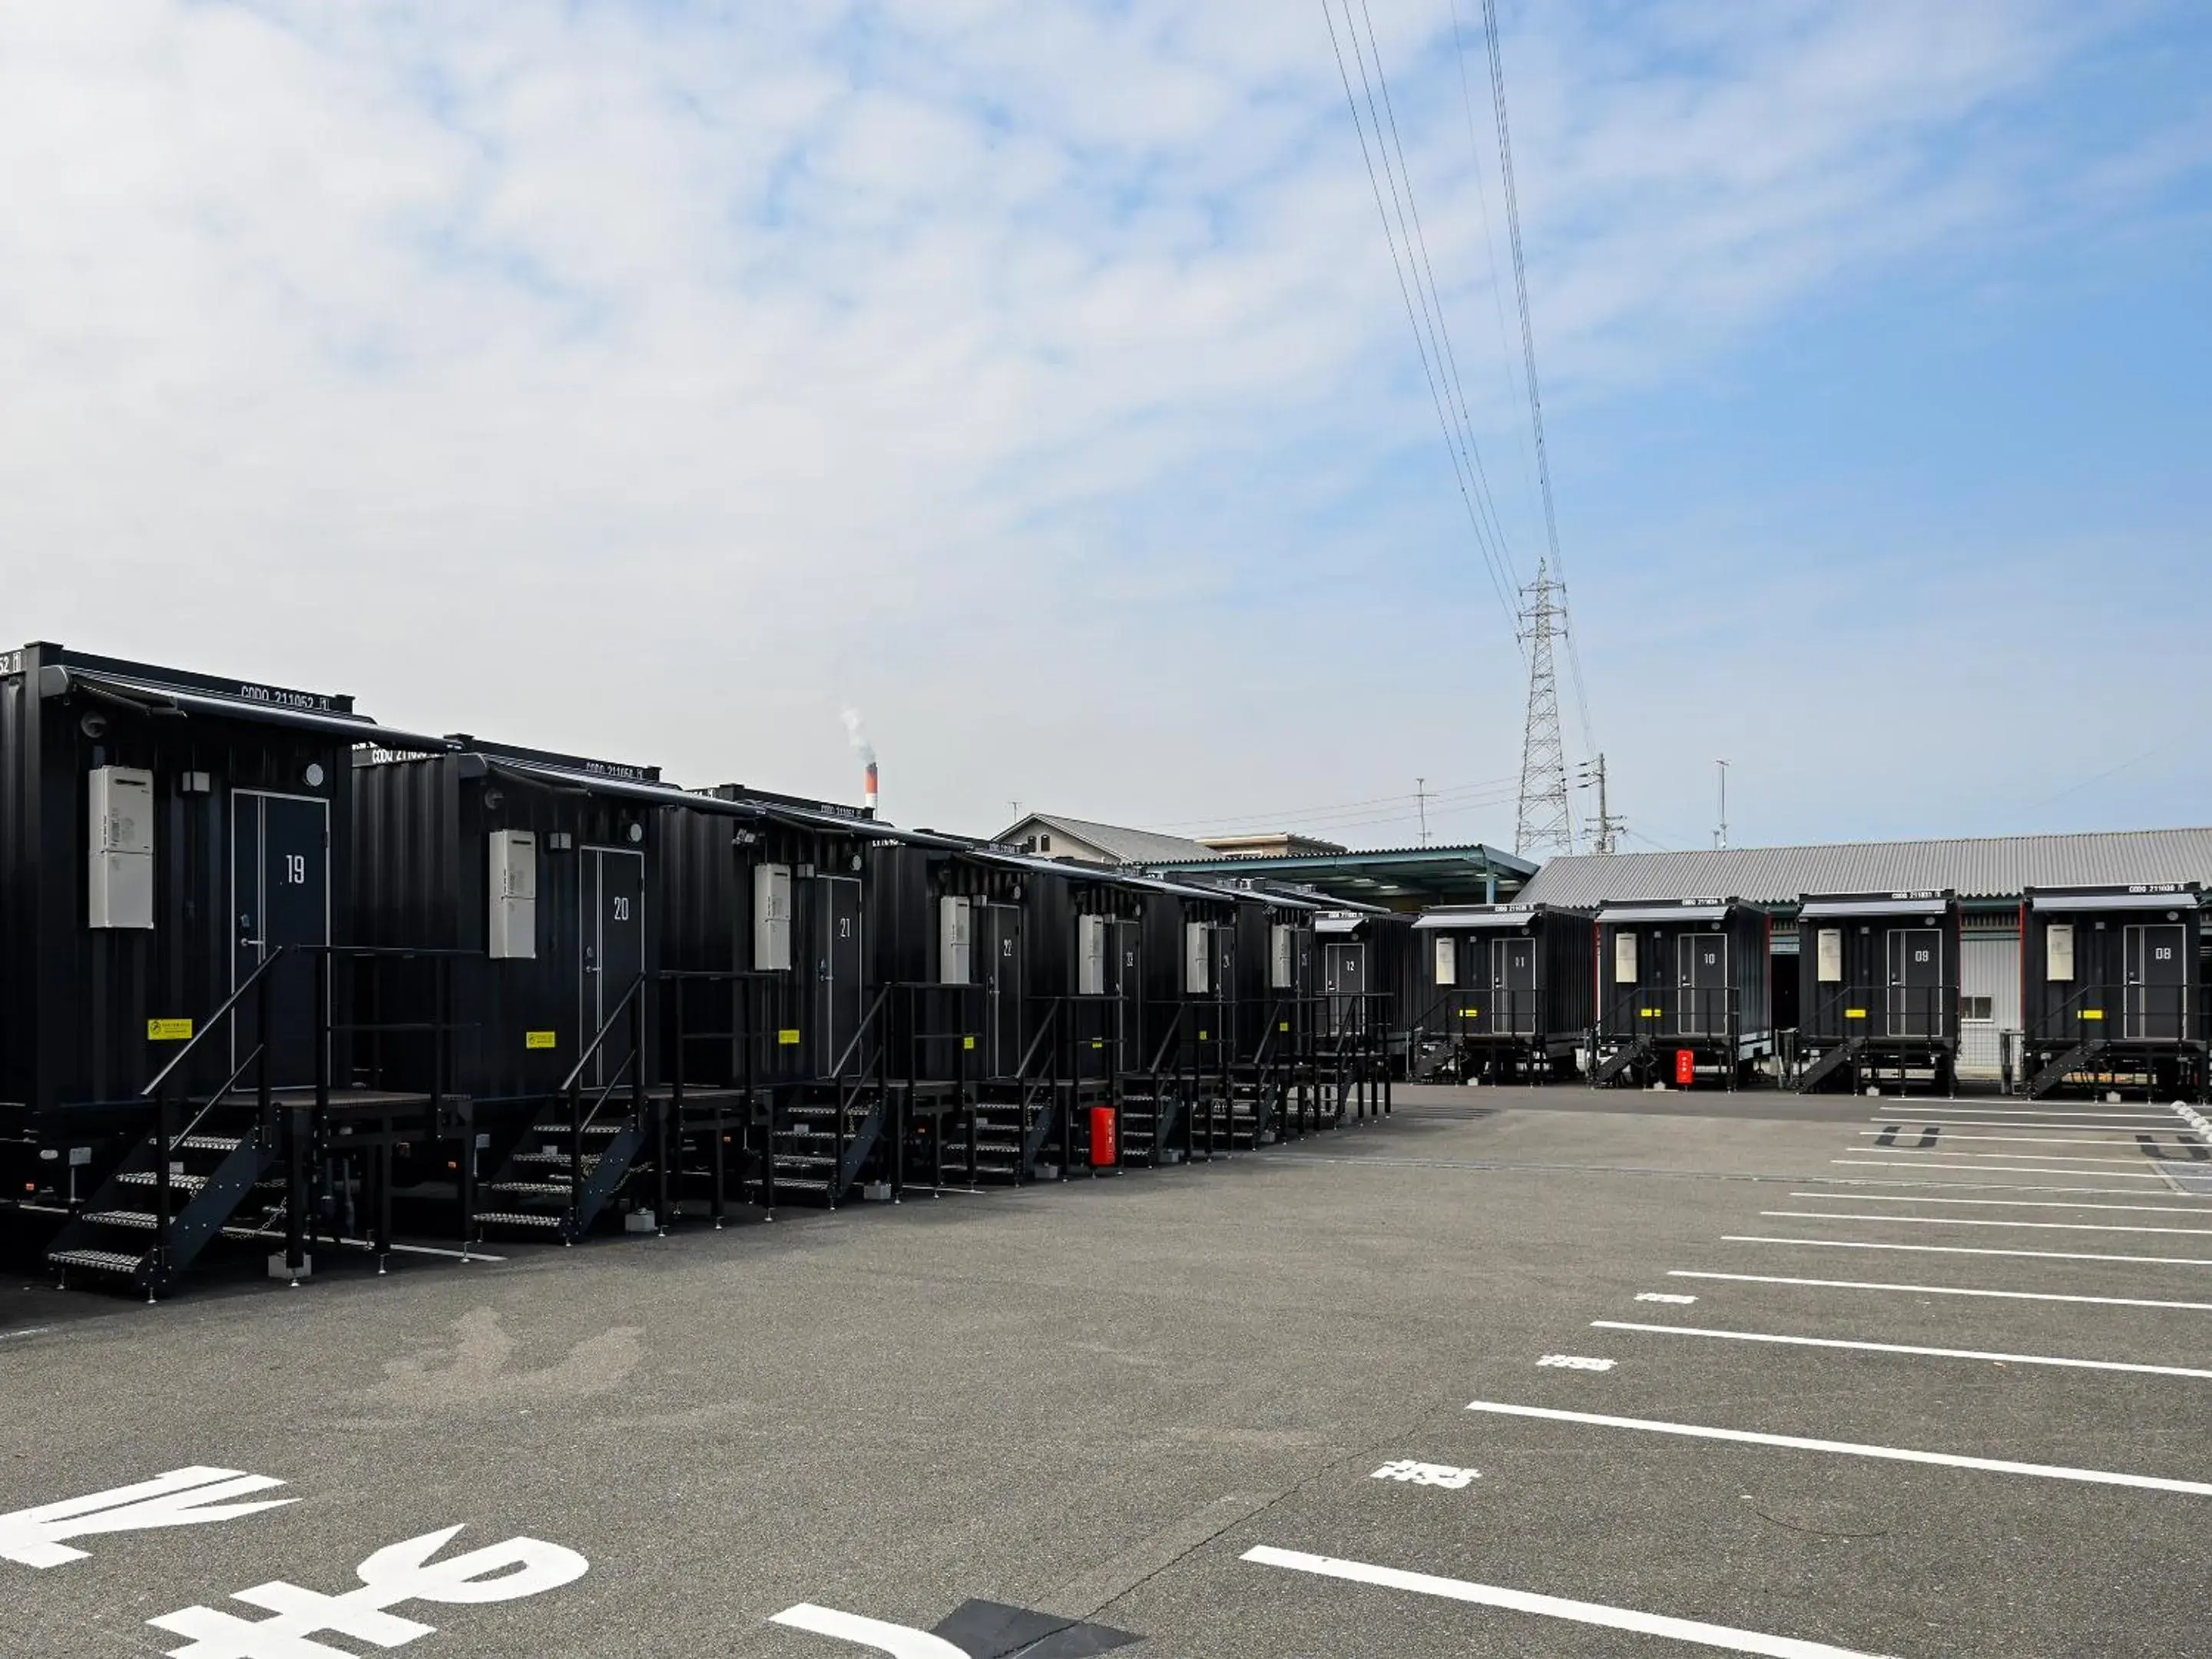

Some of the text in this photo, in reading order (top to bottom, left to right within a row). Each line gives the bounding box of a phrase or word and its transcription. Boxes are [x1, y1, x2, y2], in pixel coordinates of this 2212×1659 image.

[285, 854, 305, 883] 19
[614, 896, 629, 921] 20
[840, 918, 850, 937] 21
[1003, 939, 1012, 956] 22
[2155, 948, 2172, 959] 08
[1704, 953, 1716, 964] 10
